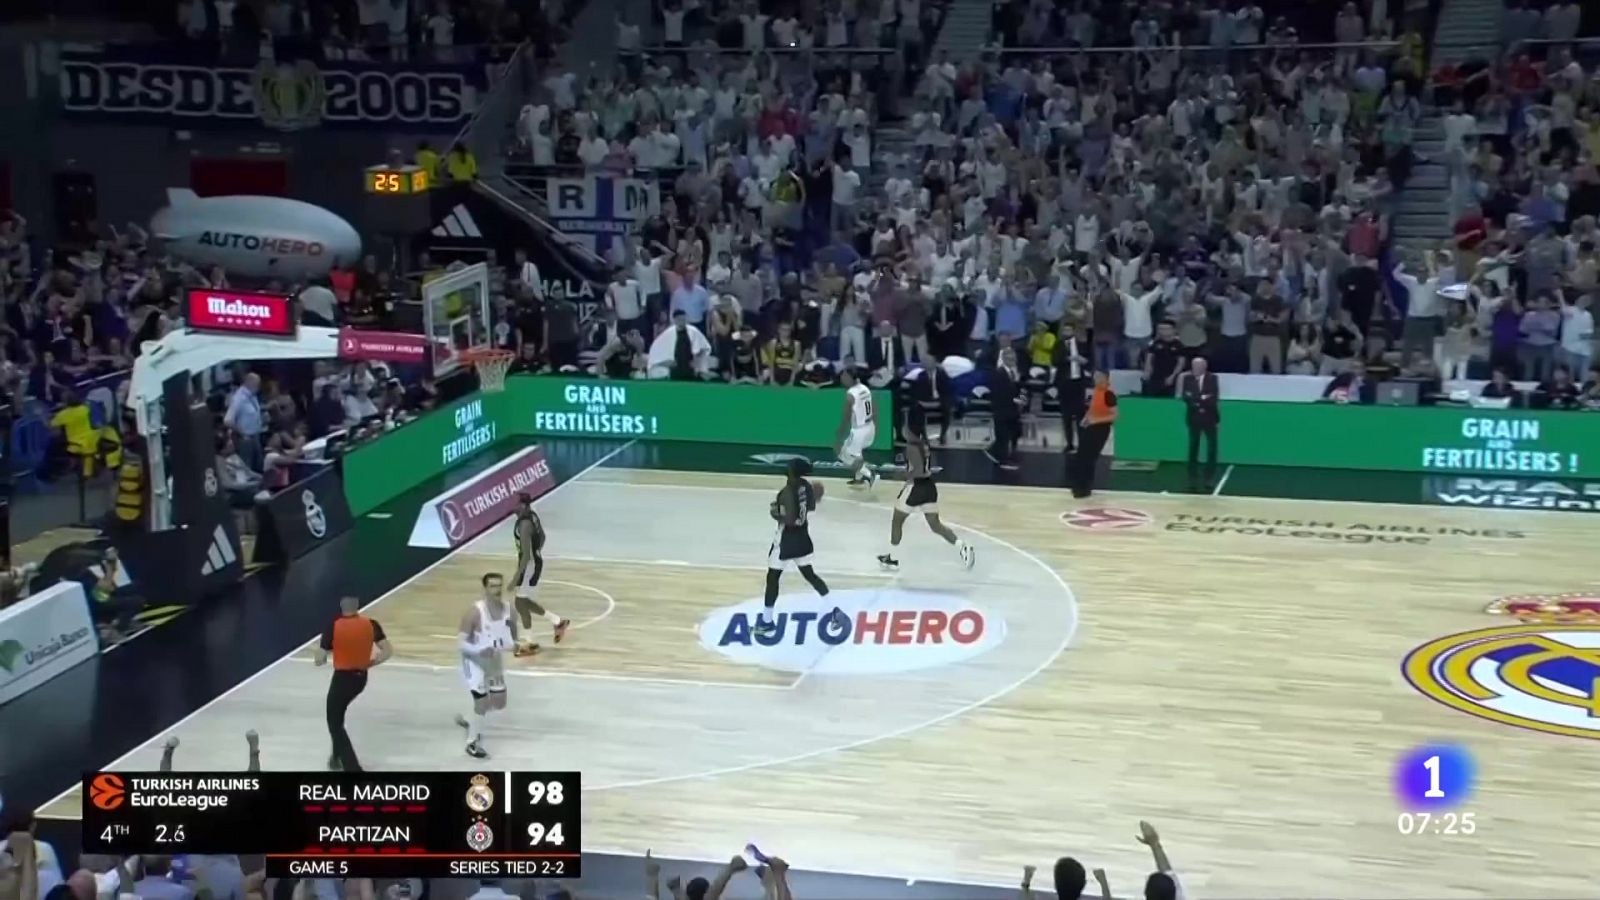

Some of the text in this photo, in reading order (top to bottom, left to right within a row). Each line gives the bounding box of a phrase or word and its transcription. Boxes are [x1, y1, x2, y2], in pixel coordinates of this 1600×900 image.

[62, 62, 256, 118] DESDE
[322, 70, 464, 122] 2005
[199, 230, 324, 256] AUTOHERO
[207, 297, 271, 318] Mahou
[564, 385, 626, 404] GRAIN
[455, 400, 482, 428] GRAIN
[535, 412, 658, 434] FERTILISERS !
[1462, 418, 1540, 440] GRAIN
[442, 424, 490, 465] FERTILISERS
[1422, 448, 1579, 473] FERTILISERS !
[463, 459, 550, 520] TURKISH AIRLINES
[1164, 521, 1433, 545] EuroLeague
[1173, 513, 1526, 540] TURKISH AIRLINES
[718, 609, 985, 647] AUTOHERO
